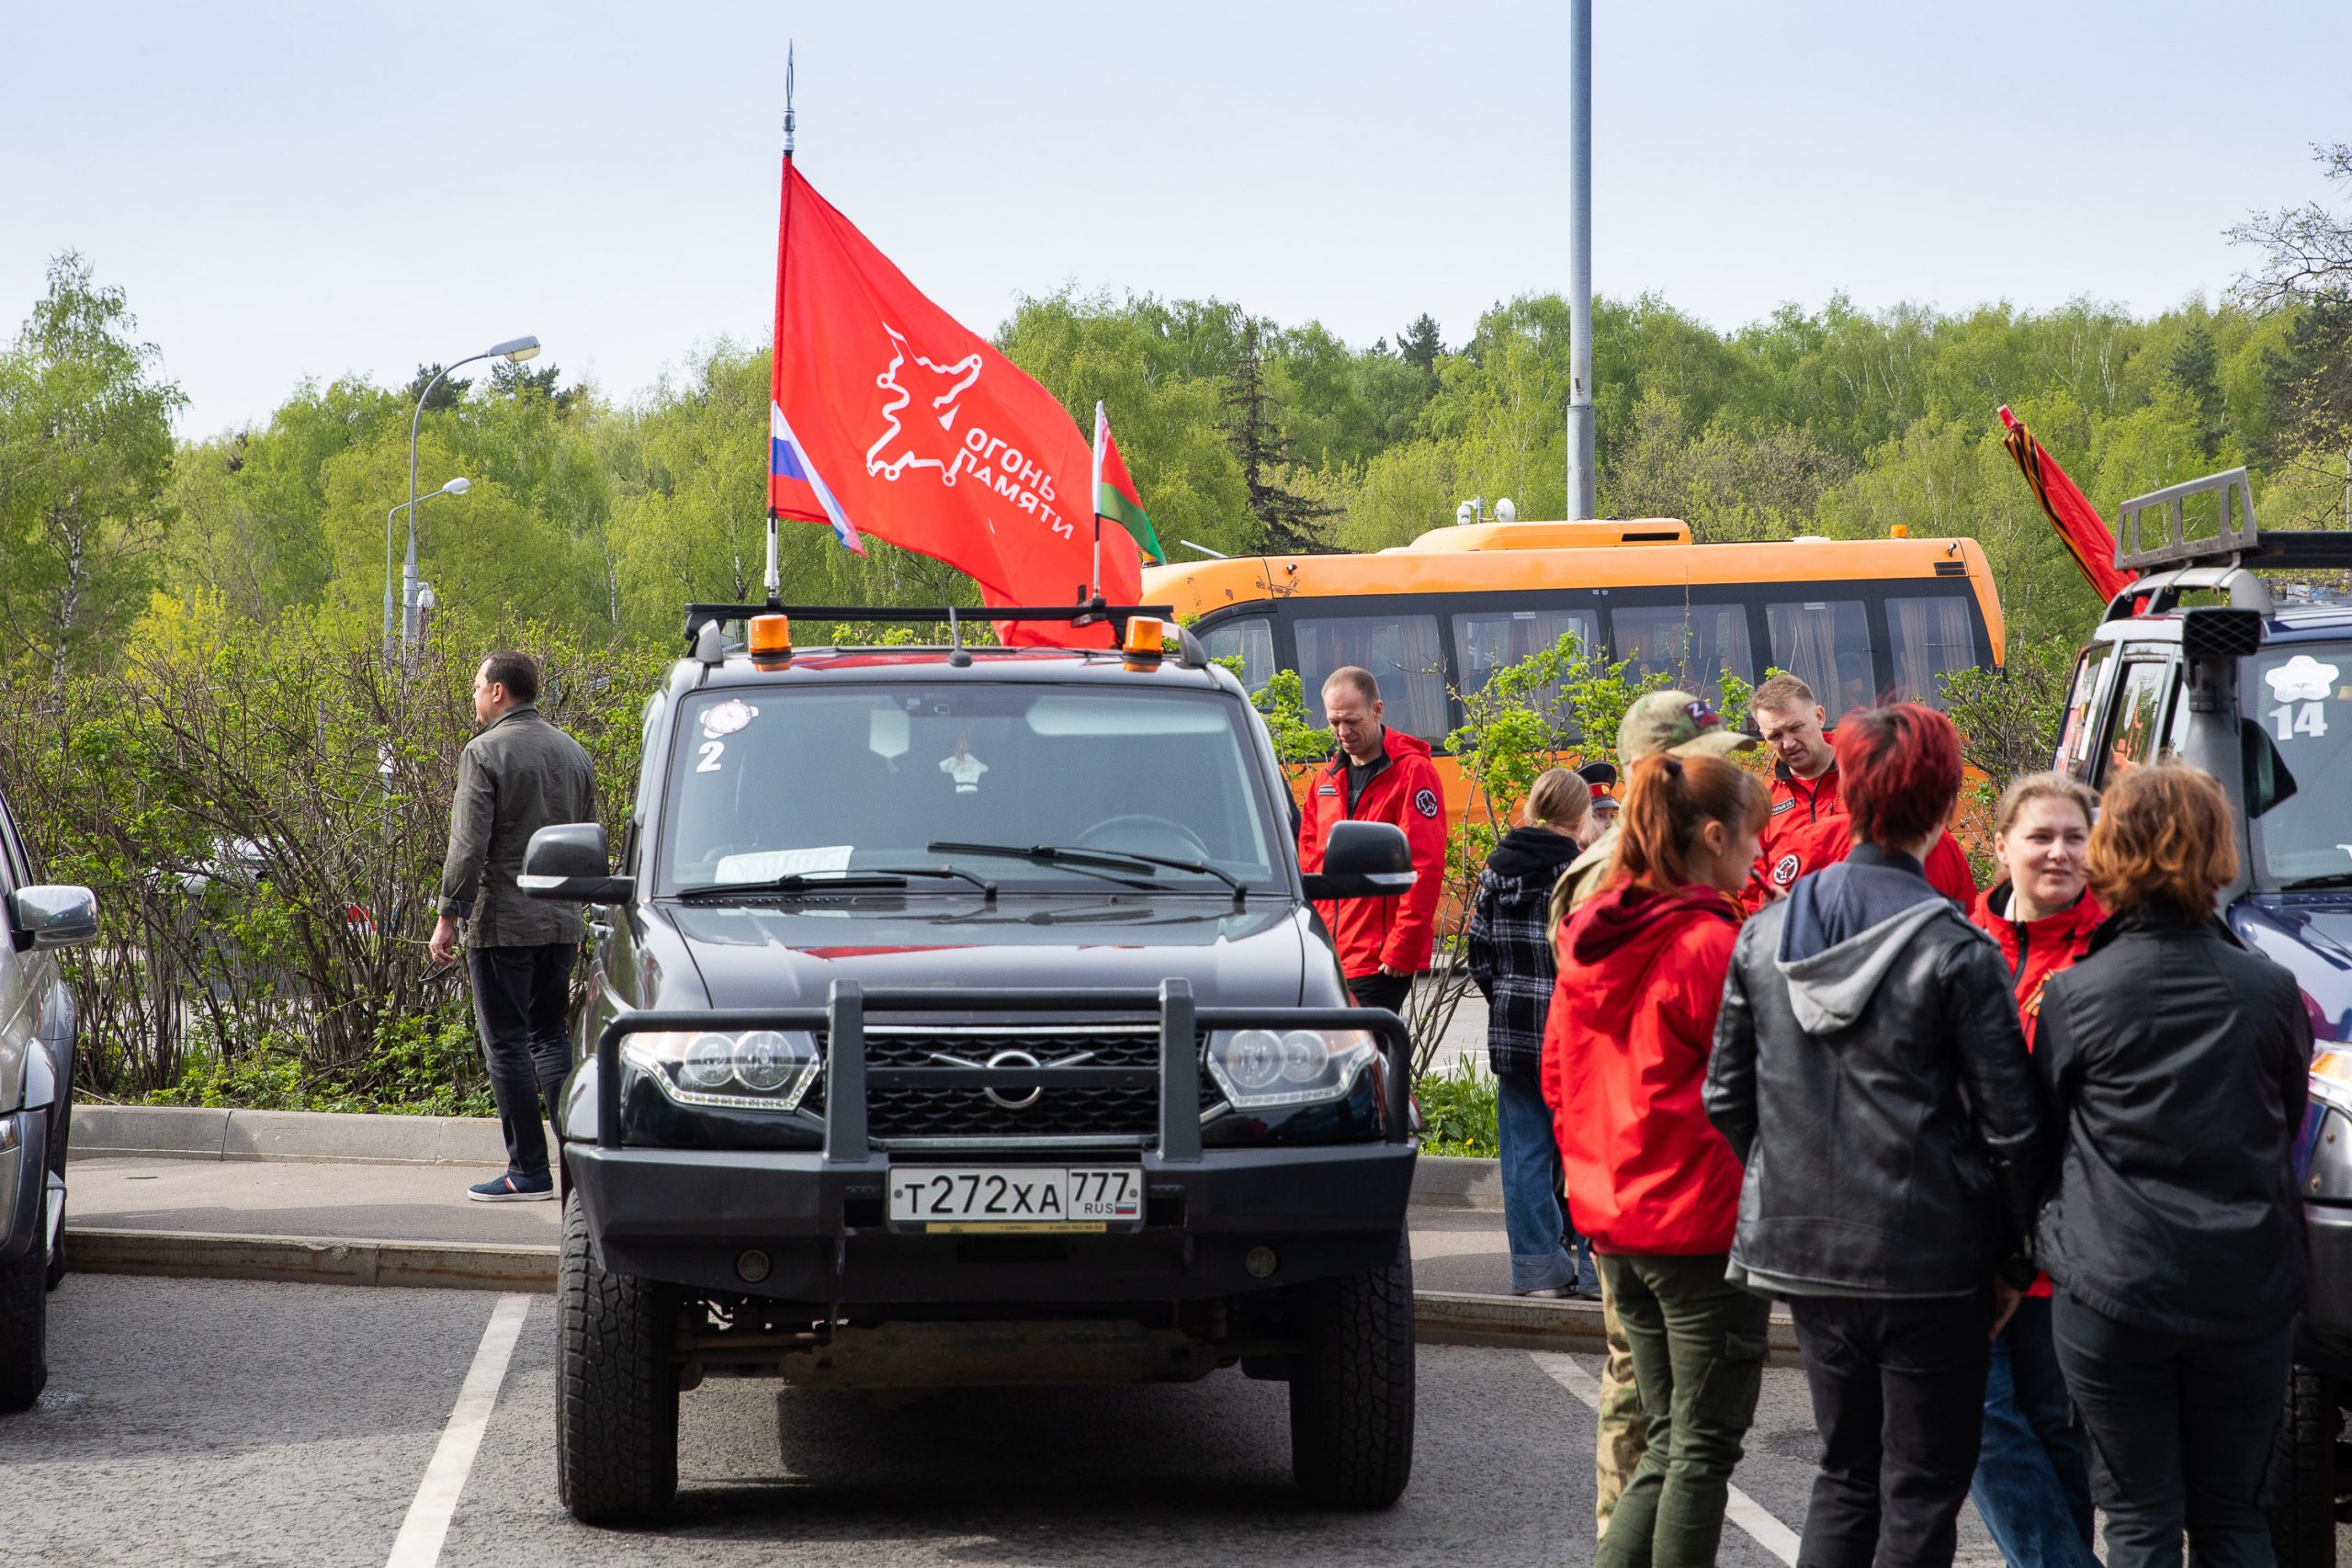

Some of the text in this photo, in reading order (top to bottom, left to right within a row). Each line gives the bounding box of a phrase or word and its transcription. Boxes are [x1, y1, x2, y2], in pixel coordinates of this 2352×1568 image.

[966, 427, 1056, 502] ОГОНЬ
[960, 446, 1074, 540] ПАМЯТИ
[2268, 701, 2328, 740] 14
[696, 740, 725, 773] 2
[1070, 1172, 1130, 1201] 777
[1084, 1202, 1114, 1213] RUS
